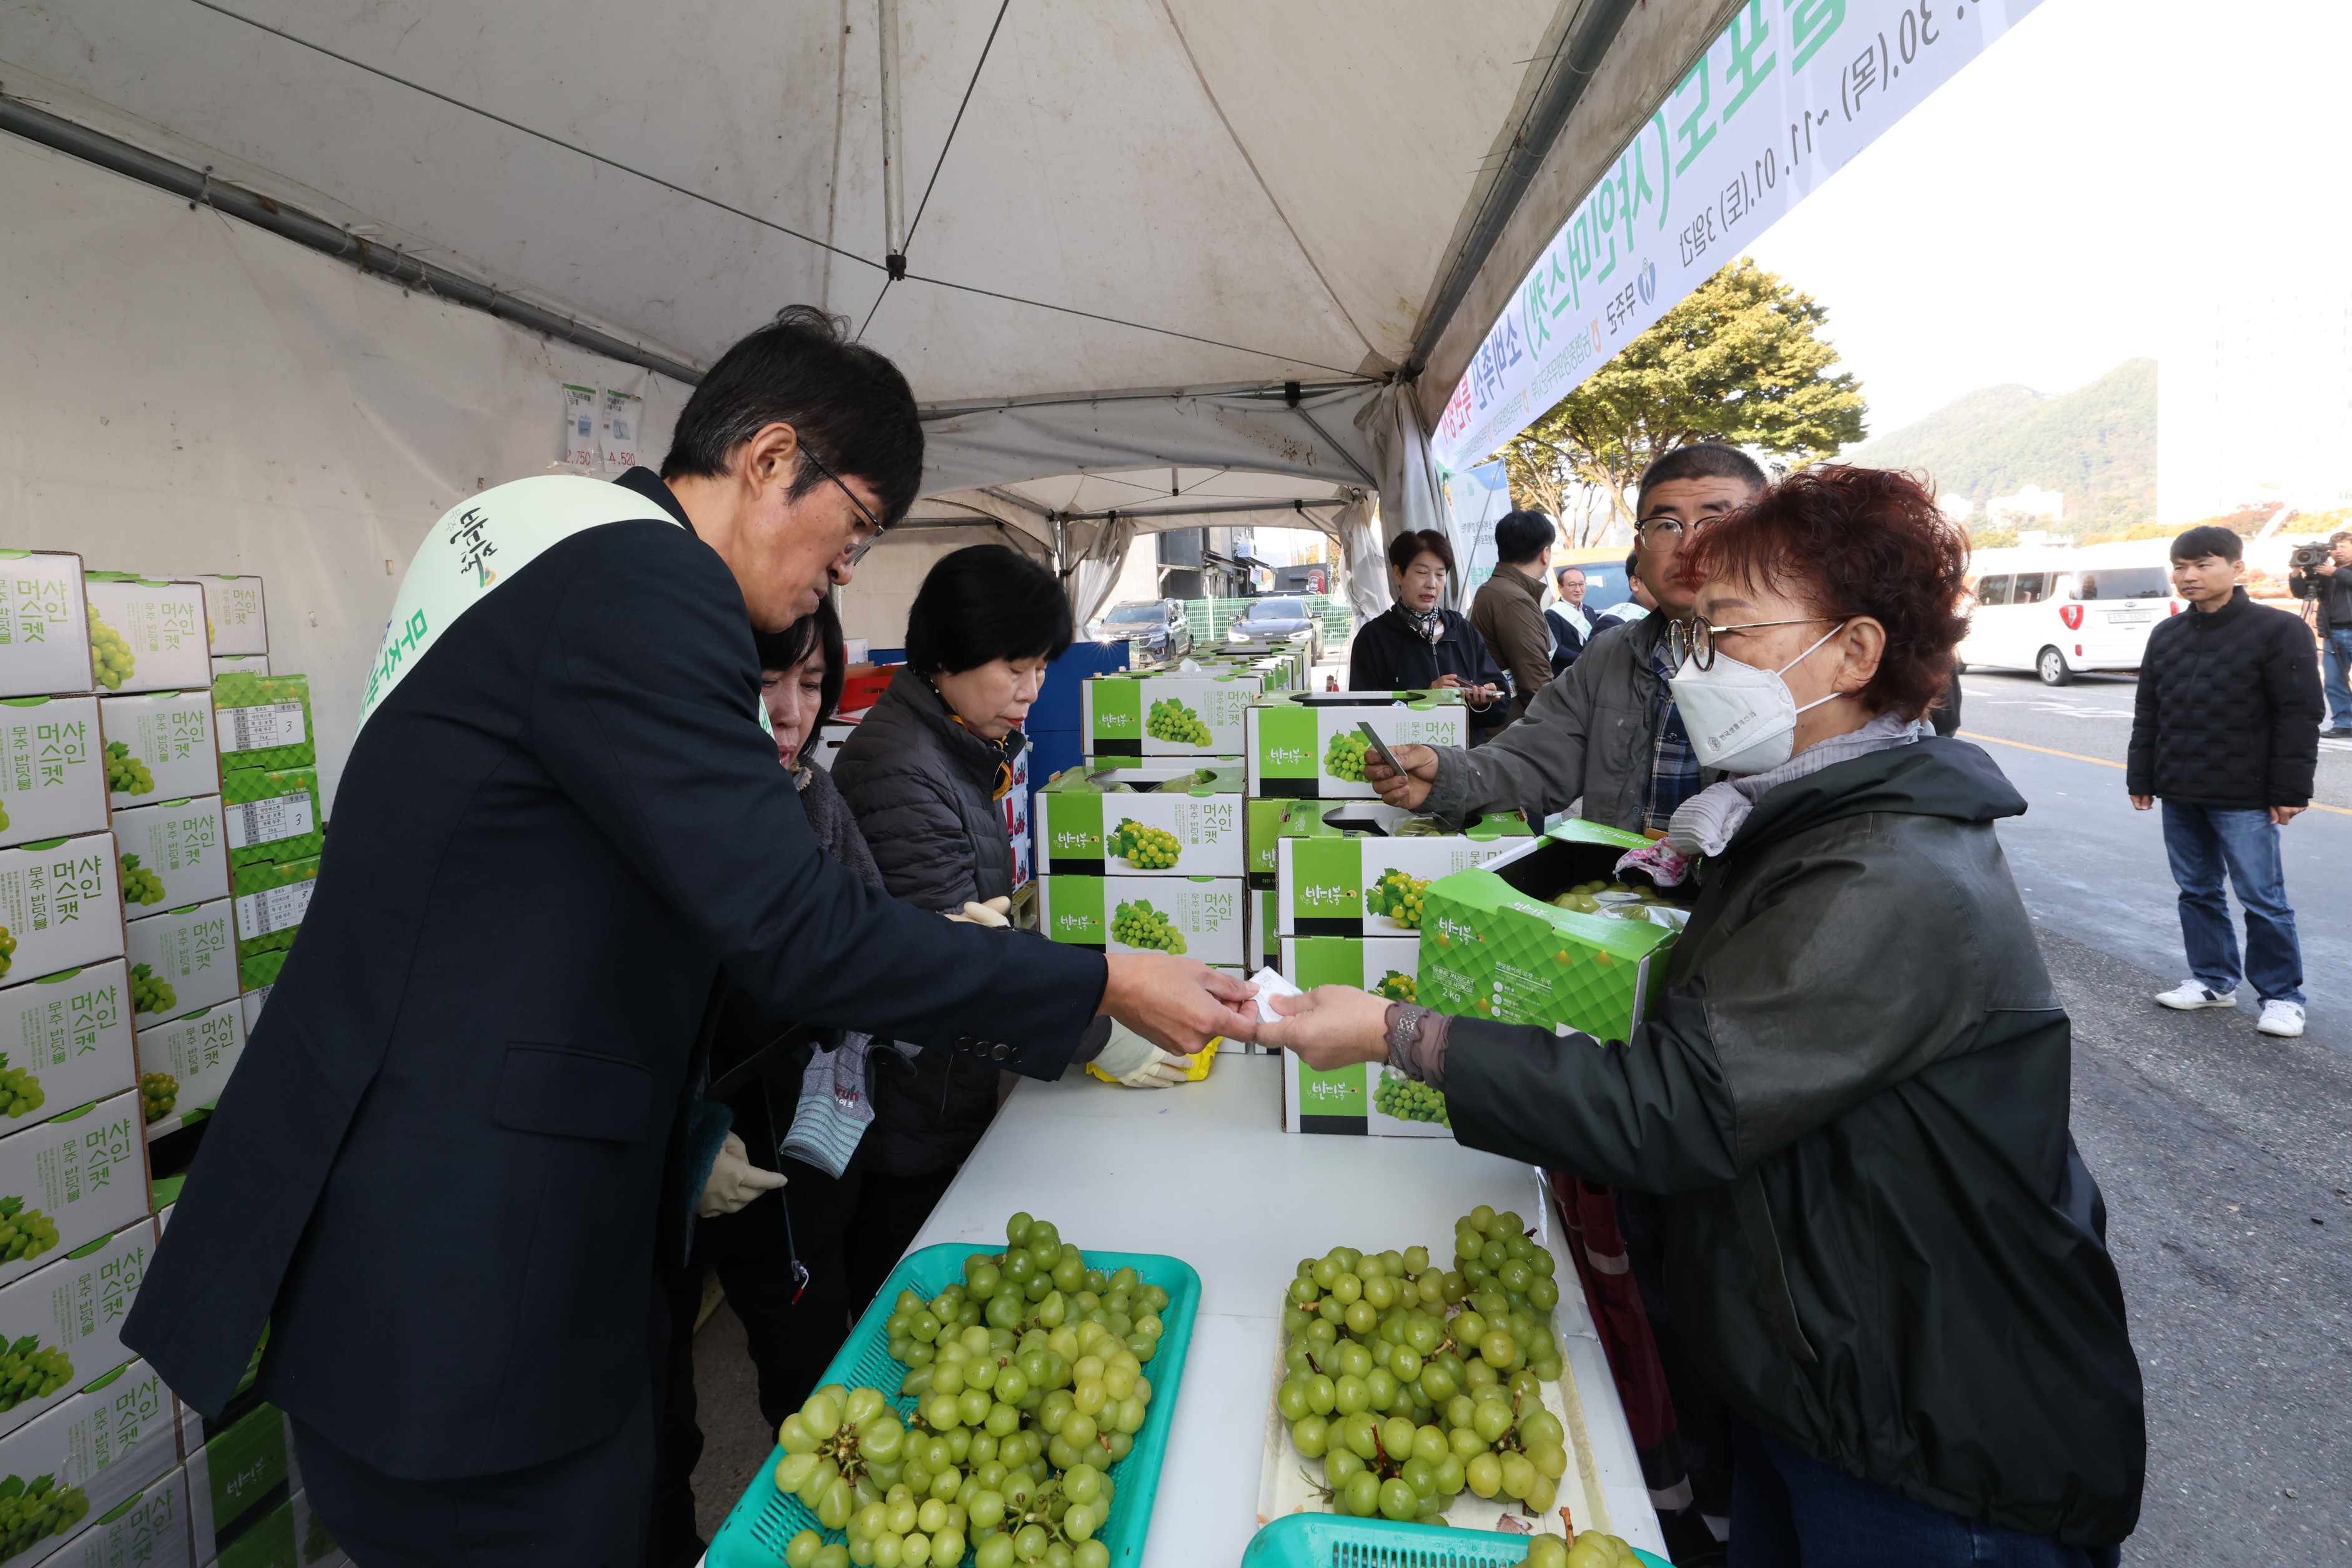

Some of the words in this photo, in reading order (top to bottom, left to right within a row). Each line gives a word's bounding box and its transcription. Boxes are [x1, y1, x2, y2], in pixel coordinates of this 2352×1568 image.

[609, 451, 635, 466] 4,520
[445, 508, 462, 532] 무주
[450, 506, 498, 588] 반딧불
[17, 579, 45, 643] 머스켓
[43, 579, 68, 623] 샤인
[145, 603, 156, 621] 무주
[245, 589, 256, 614] 샤인
[162, 603, 180, 650] 머스켓
[179, 603, 195, 635] 샤인
[147, 624, 159, 652] 반딧불
[1216, 691, 1224, 704] 무주
[1228, 691, 1240, 726] 머스켓
[156, 714, 166, 731] 무주
[189, 710, 204, 742] 샤인
[286, 721, 292, 733] 3
[1102, 713, 1129, 728] 반딧불
[1411, 722, 1420, 737] 무주
[11, 726, 29, 750] 무주
[62, 721, 86, 764] 샤인
[157, 735, 169, 762] 반딧불
[172, 711, 190, 759] 머스켓
[37, 723, 64, 786] 머스켓
[1270, 747, 1305, 766] 반딧불
[14, 754, 32, 791] 반딧불
[295, 814, 302, 826] 3
[1189, 804, 1198, 819] 무주
[1203, 804, 1217, 844] 머스캣
[1218, 804, 1233, 831] 샤인
[167, 821, 177, 840] 무주
[183, 817, 200, 865] 머스켓
[199, 814, 215, 848] 샤인
[1058, 831, 1088, 849] 반딧불
[1190, 822, 1199, 844] 반딧불
[168, 842, 179, 870] 반딧불
[28, 866, 45, 890] 무주
[79, 855, 102, 899] 샤인
[54, 860, 79, 924] 머스캣
[302, 890, 308, 899] 3
[1191, 894, 1199, 907] 무주
[1299, 895, 1310, 905] 무주
[1305, 884, 1343, 905] 반딧불
[31, 894, 47, 930] 반딧불
[1205, 893, 1218, 932] 머스켓
[1218, 893, 1233, 920] 샤인
[210, 918, 225, 952] 샤인
[1060, 914, 1090, 931] 반딧불
[1192, 910, 1200, 932] 반딧불
[1439, 916, 1473, 945] 반딧불
[177, 928, 188, 946] 무주
[193, 922, 210, 970] 머스켓
[179, 949, 190, 976] 반딧불
[1433, 966, 1448, 976] SHINE
[1450, 972, 1475, 986] MUSCAT
[1496, 961, 1521, 975] 반딧불이의
[1523, 970, 1533, 980] 고장
[1541, 977, 1552, 986] 무주
[47, 1001, 63, 1025] 무주
[95, 985, 117, 1029] 샤인
[71, 992, 96, 1056] 머스켓
[186, 1027, 197, 1045] 무주
[218, 1013, 234, 1048] 샤인
[50, 1028, 66, 1065] 반딧불
[202, 1019, 219, 1069] 머스캣
[188, 1047, 199, 1075] 반딧불
[1312, 1081, 1349, 1100] 반딧불
[62, 1140, 78, 1163] 무주
[109, 1118, 131, 1163] 샤인
[86, 1127, 110, 1192] 머스켓
[65, 1166, 80, 1203] 반딧불
[123, 1247, 144, 1293] 샤인
[77, 1273, 92, 1298] 무주
[101, 1258, 124, 1323] 머스켓
[80, 1299, 94, 1337] 반딧불
[138, 1375, 159, 1421] 샤인
[93, 1406, 107, 1431] 무주
[116, 1388, 138, 1454] 머스켓
[95, 1432, 110, 1469] 반딧불
[153, 1488, 173, 1536] 샤인
